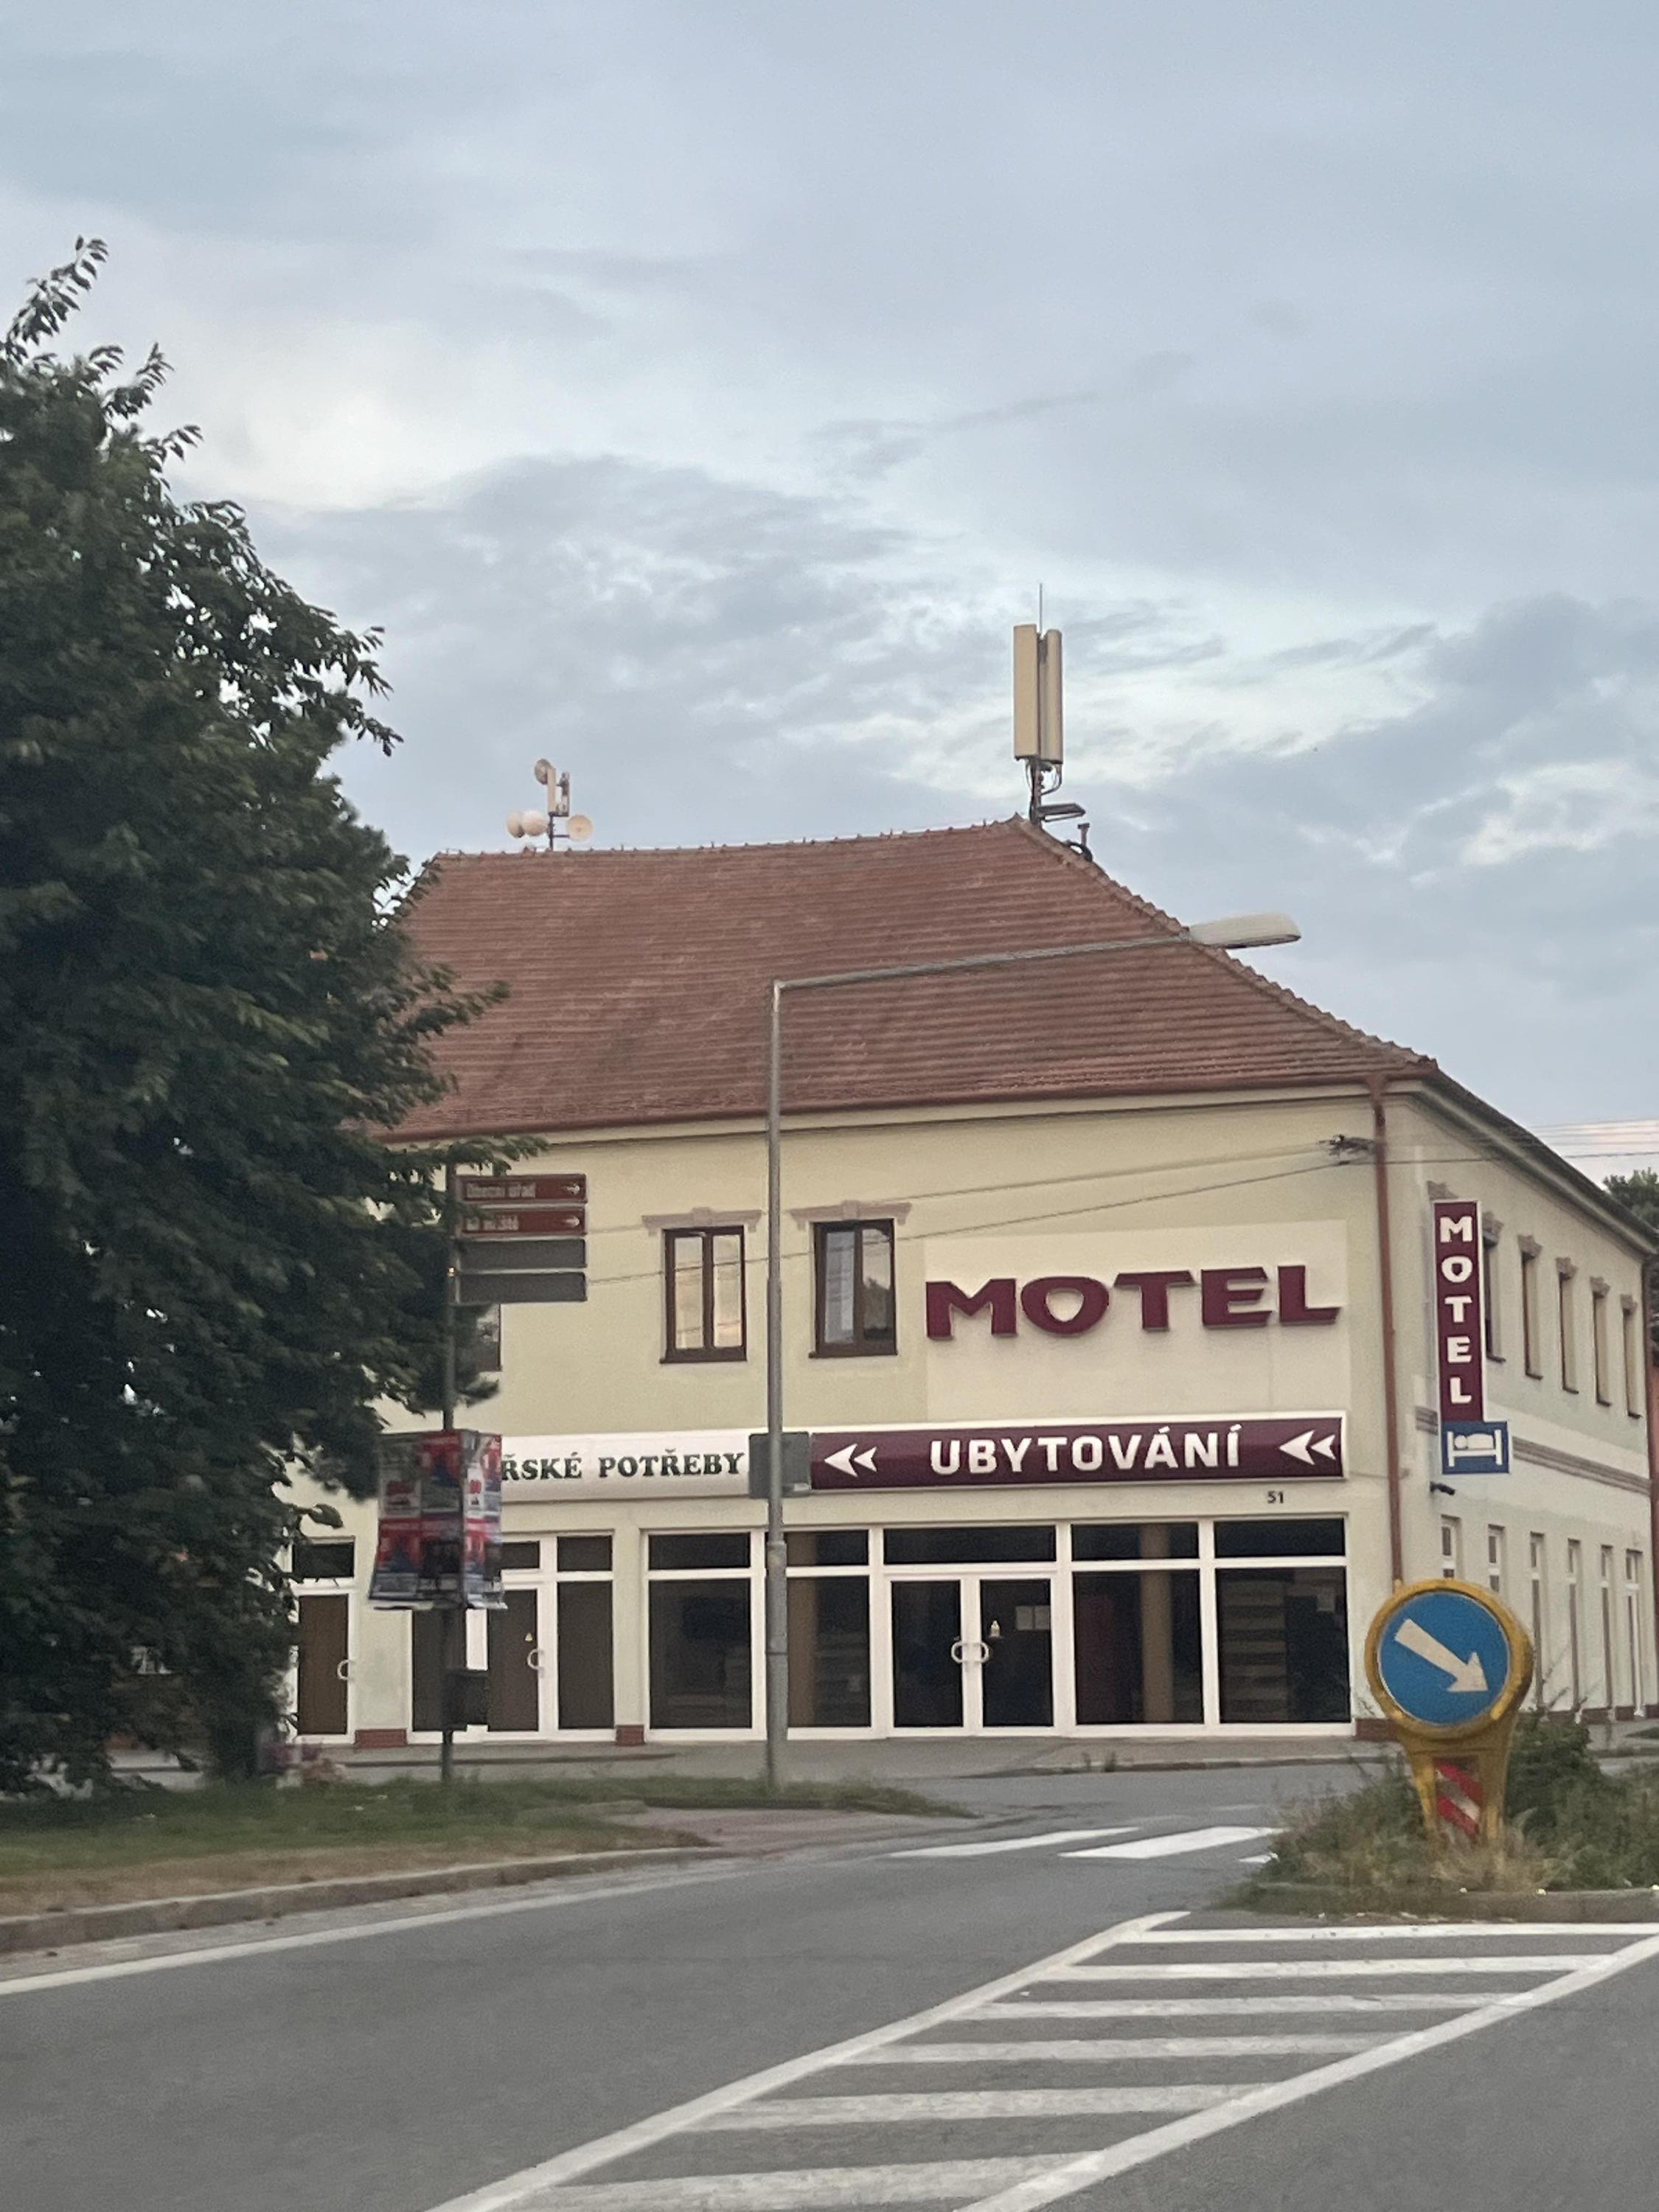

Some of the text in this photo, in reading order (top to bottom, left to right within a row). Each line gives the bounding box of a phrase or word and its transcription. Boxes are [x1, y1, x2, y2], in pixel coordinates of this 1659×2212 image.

[925, 1265, 1342, 1340] MOTEL
[1440, 1216, 1473, 1404] MOTEL
[598, 1447, 745, 1478] POTŘEBY
[930, 1423, 1242, 1475] UBYTOVÁNÍ
[1267, 1490, 1284, 1504] 51
